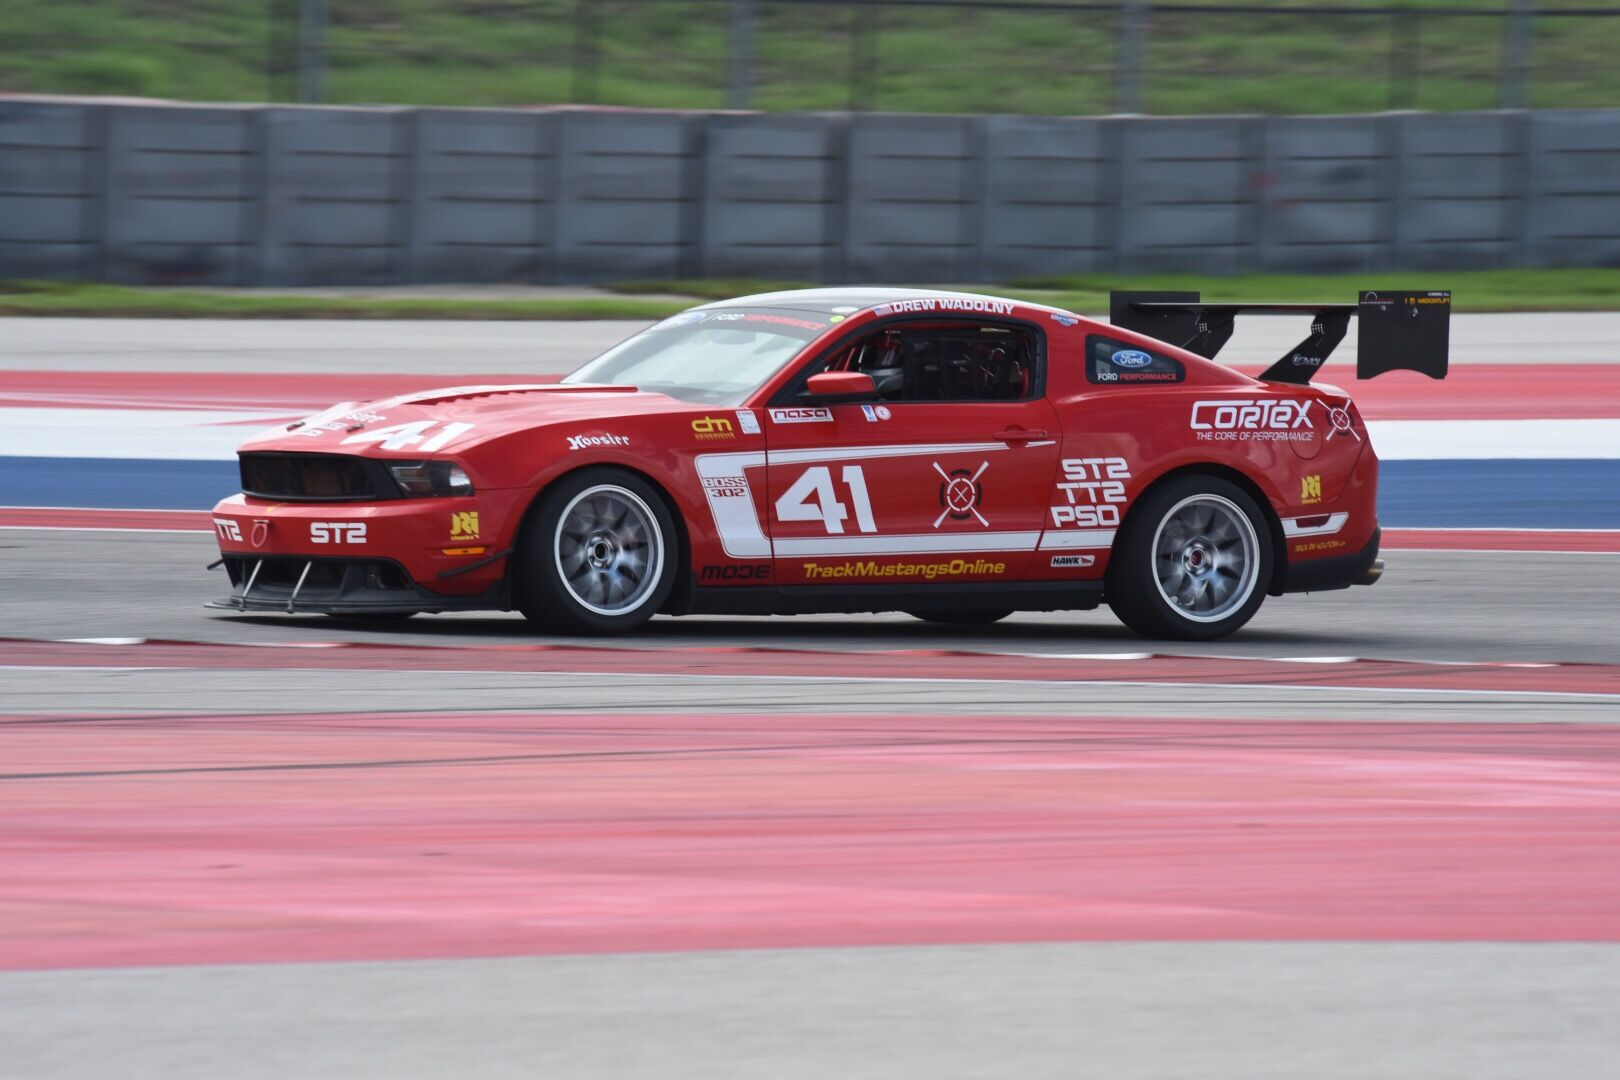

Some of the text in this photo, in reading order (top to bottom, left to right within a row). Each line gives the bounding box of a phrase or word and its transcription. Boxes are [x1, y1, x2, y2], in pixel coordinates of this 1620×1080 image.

[891, 300, 1016, 314] DREW WADOLNY
[1120, 353, 1145, 364] Ford
[1097, 373, 1118, 381] FORD
[774, 408, 829, 419] nasa
[341, 420, 476, 451] 41
[566, 432, 630, 450] Hoosier
[1197, 432, 1315, 441] THE CORE OF PERFORMANCE
[1062, 457, 1131, 480] ST2
[703, 477, 747, 487] BOSS
[711, 488, 747, 497] 302
[775, 465, 878, 533] 41
[1056, 481, 1127, 504] TT2
[214, 518, 243, 541] TT2
[310, 522, 367, 543] ST2
[803, 559, 1006, 579] TrackMustangsOnline
[1052, 557, 1080, 566] HAWK
